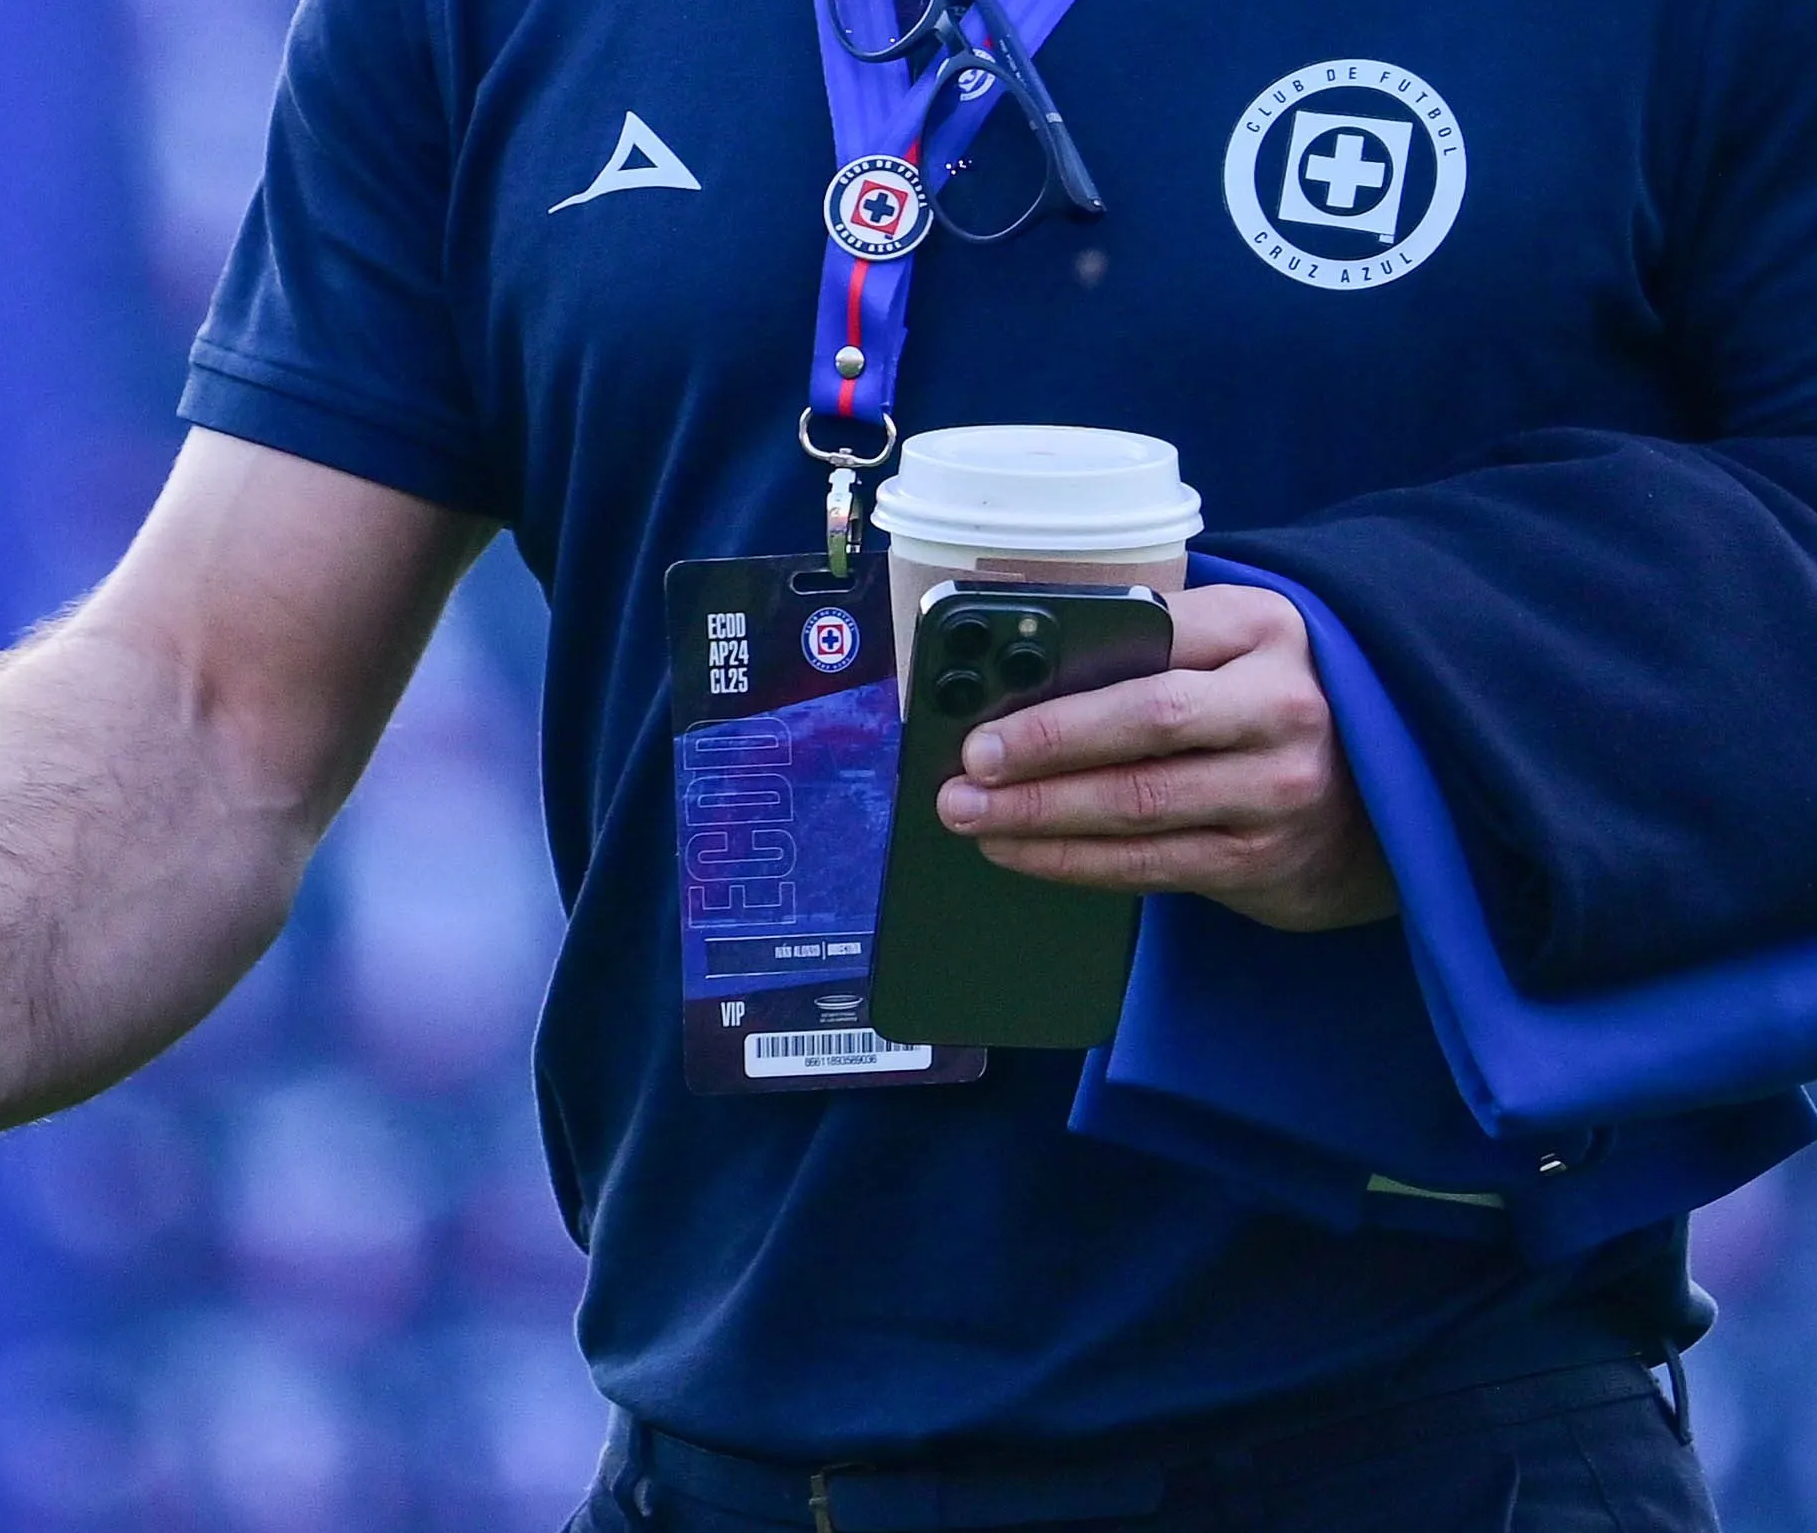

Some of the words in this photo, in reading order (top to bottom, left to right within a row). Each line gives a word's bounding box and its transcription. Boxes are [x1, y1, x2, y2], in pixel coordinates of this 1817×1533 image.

[1245, 79, 1305, 135] CLUB
[1326, 66, 1358, 82] DE
[1379, 70, 1458, 157] FUTBOL
[1253, 231, 1319, 279] CRUZ
[1339, 252, 1413, 284] AZUL
[707, 612, 746, 639] ECDD
[709, 639, 750, 667] AP24
[710, 667, 749, 694] CL25
[683, 716, 797, 929] ECDD
[720, 1001, 745, 1027] VIP
